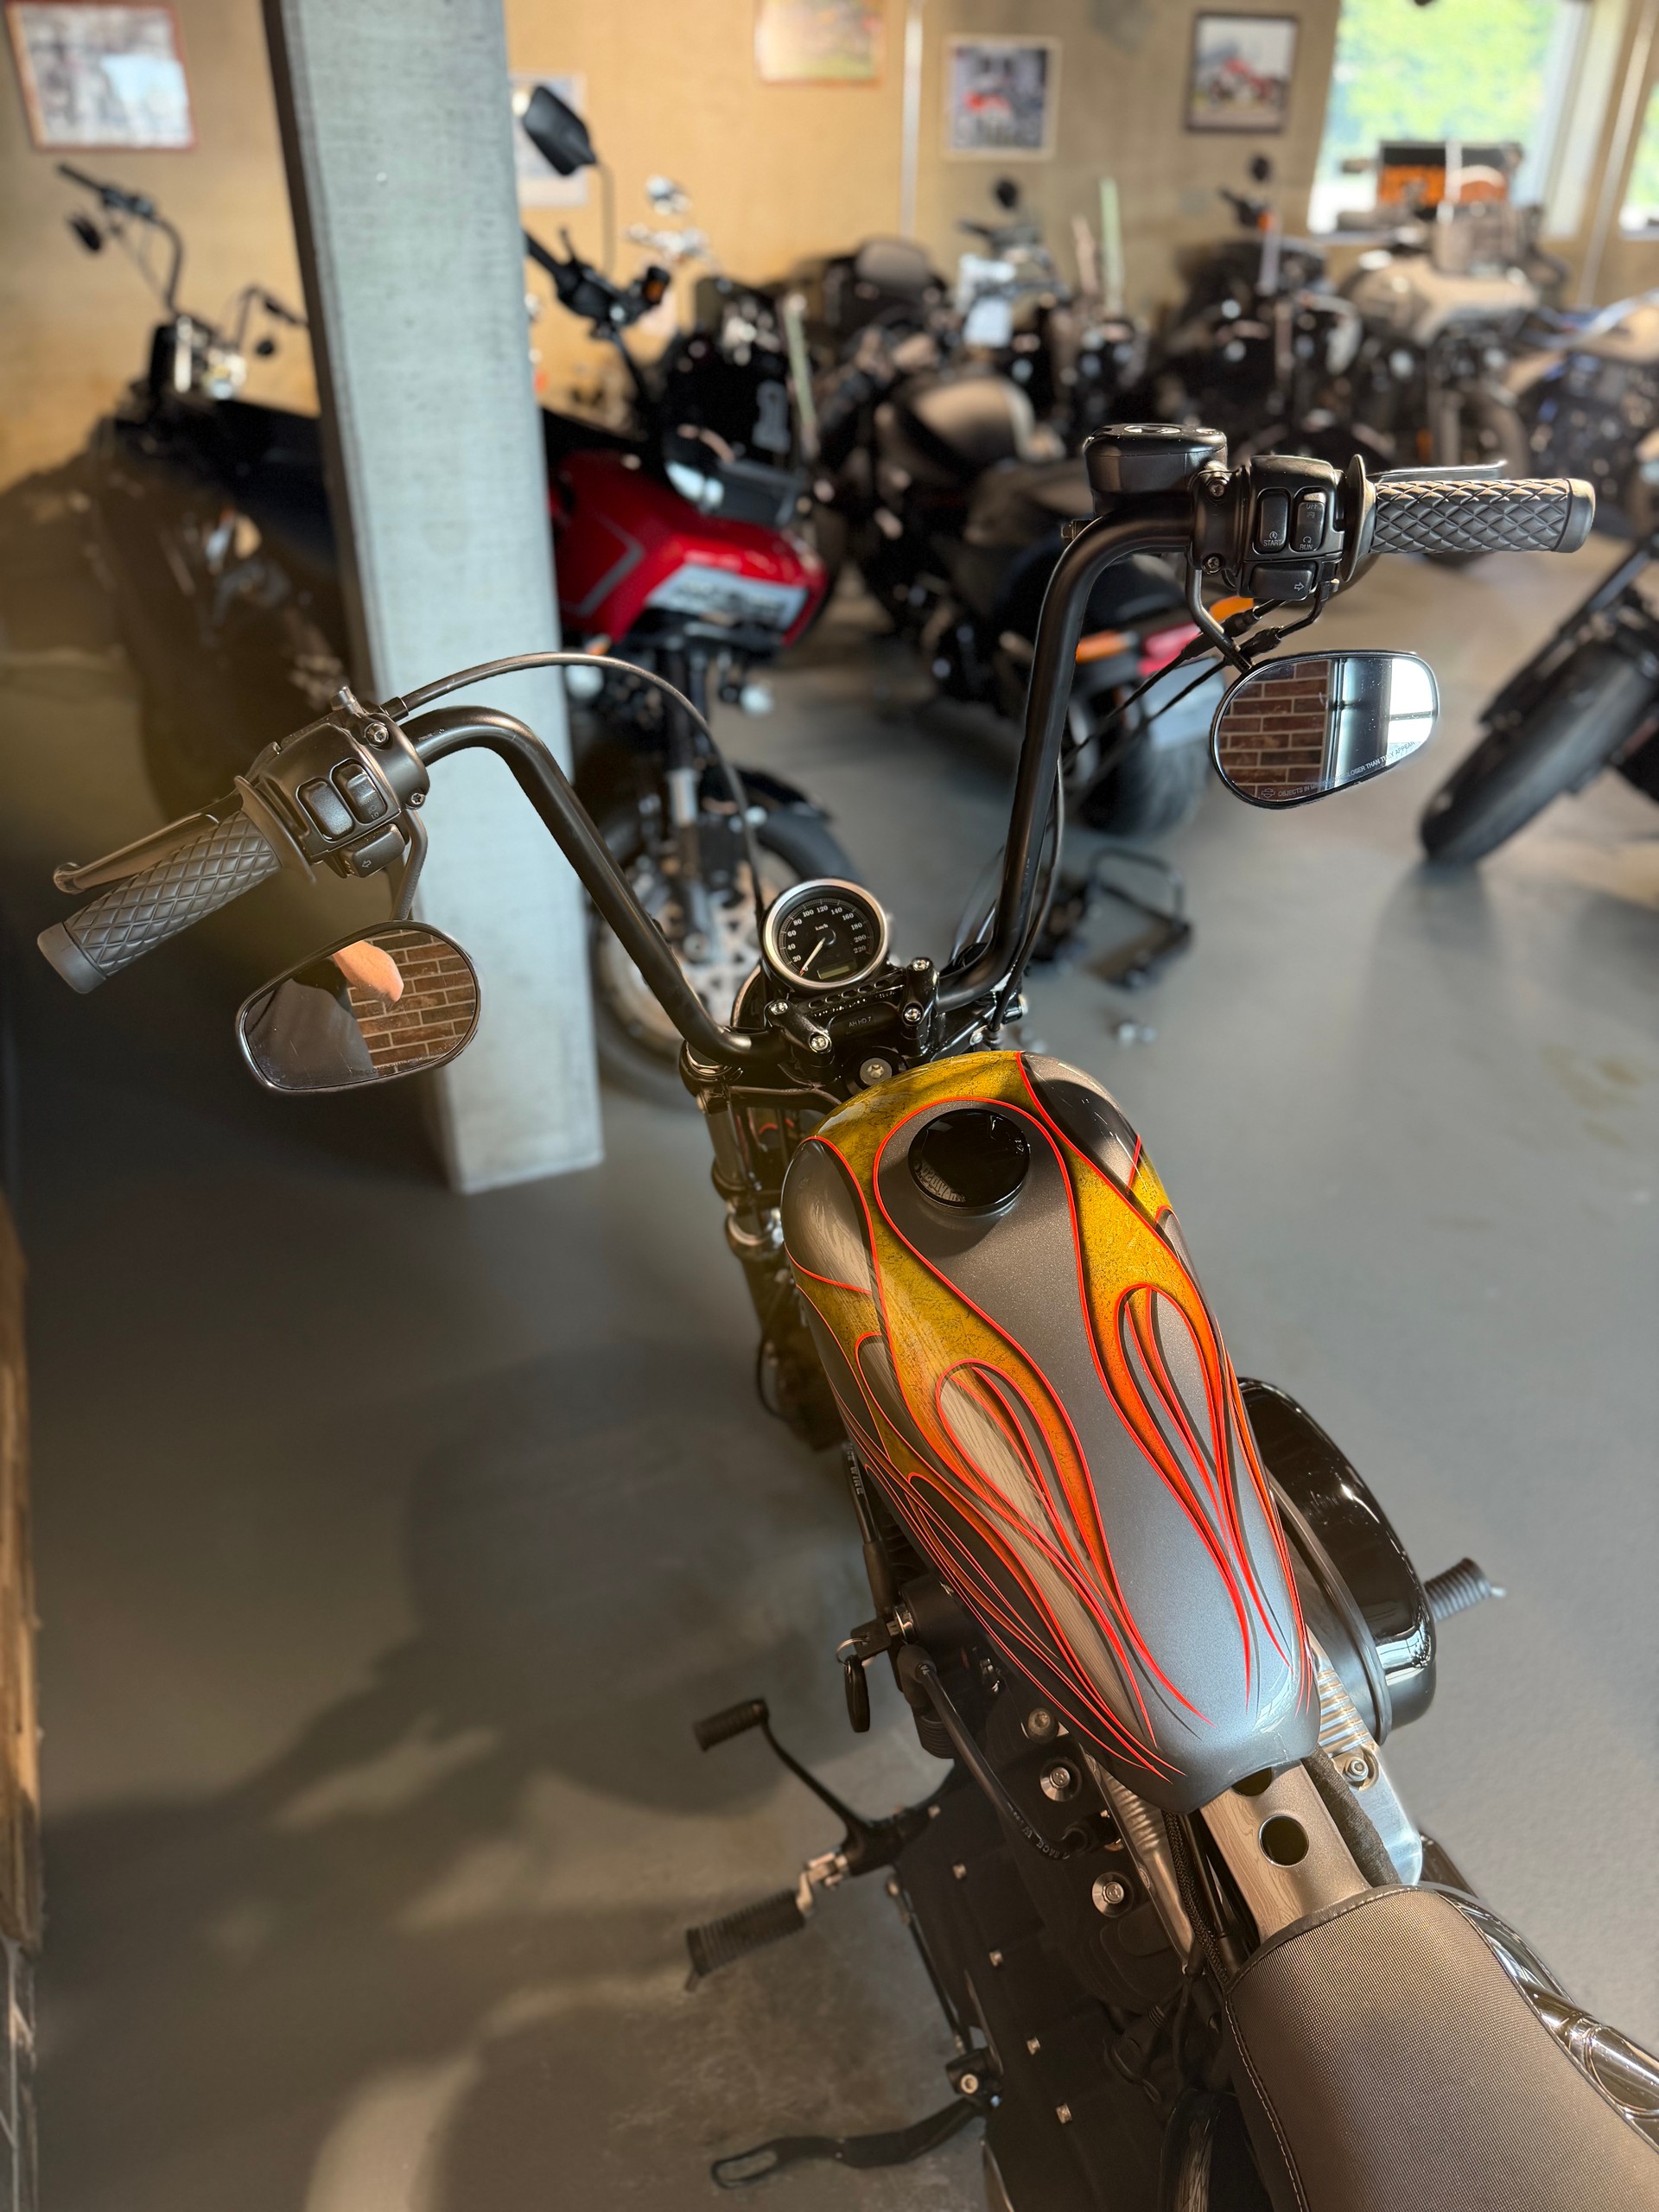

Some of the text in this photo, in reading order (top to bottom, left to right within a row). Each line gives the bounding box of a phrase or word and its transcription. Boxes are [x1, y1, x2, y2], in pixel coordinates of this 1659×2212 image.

[1278, 786, 1303, 797] OBJECTS
[1344, 766, 1365, 777] LOSER
[1366, 758, 1381, 769] THAN
[802, 909, 814, 918] 100
[817, 905, 829, 913] 120
[830, 906, 842, 915] 140
[842, 912, 854, 921] 160
[815, 923, 829, 931] km/h
[850, 922, 862, 931] 180
[854, 934, 867, 943] 200
[853, 945, 867, 954] 220
